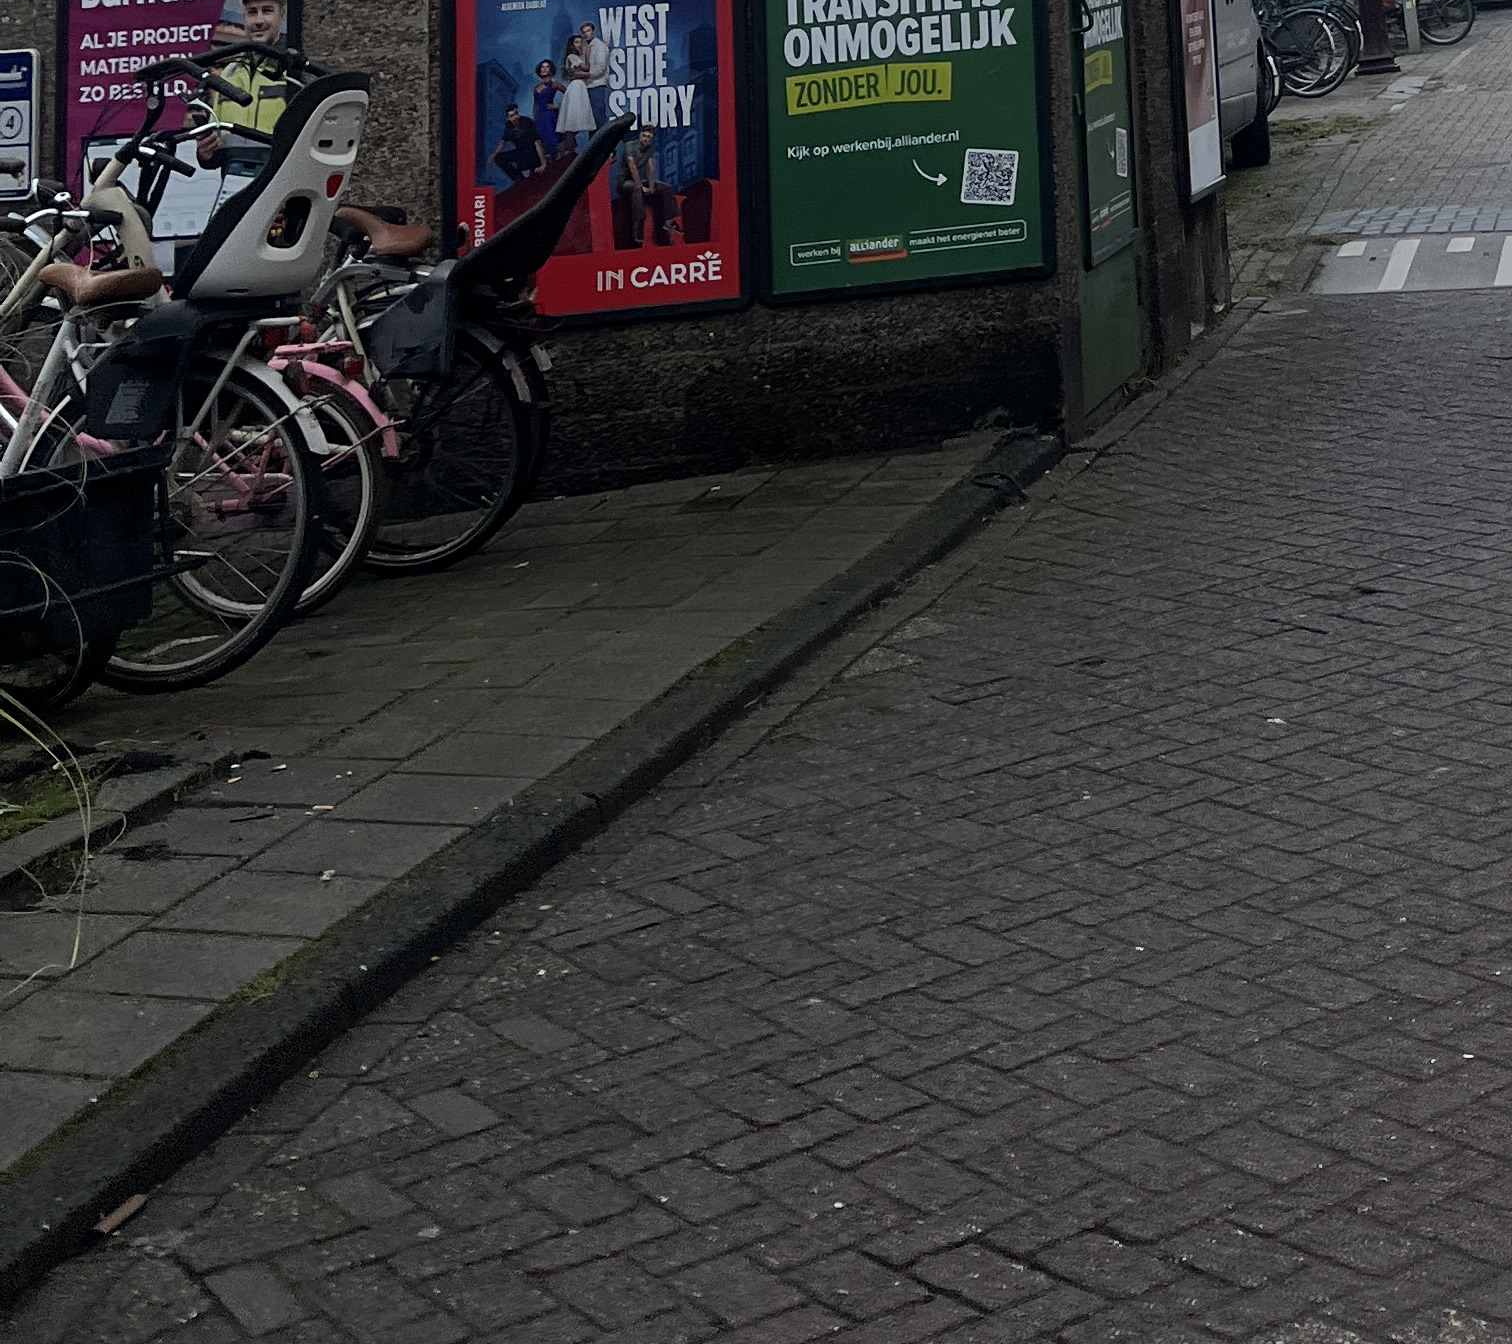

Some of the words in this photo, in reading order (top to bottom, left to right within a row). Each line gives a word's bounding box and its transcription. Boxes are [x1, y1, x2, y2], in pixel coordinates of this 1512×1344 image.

[79, 33, 104, 50] AL
[107, 31, 129, 48] JE
[131, 24, 213, 46] PROJECT
[599, 2, 670, 48] WEST
[783, 7, 1018, 68] ONMOGELIJK
[1081, 5, 1124, 49] MOGELIJK
[608, 44, 668, 90] SIDE
[79, 85, 104, 103] ZO
[793, 72, 880, 108] ZONDER
[894, 69, 942, 96] JOU.
[608, 84, 696, 131] STORY
[786, 144, 811, 160] Kijk
[813, 145, 830, 158] op
[831, 130, 961, 154] werkenbij.alliander.nl
[797, 248, 827, 259] werken
[828, 246, 841, 258] bij
[936, 234, 950, 244] het
[596, 268, 624, 292] IN
